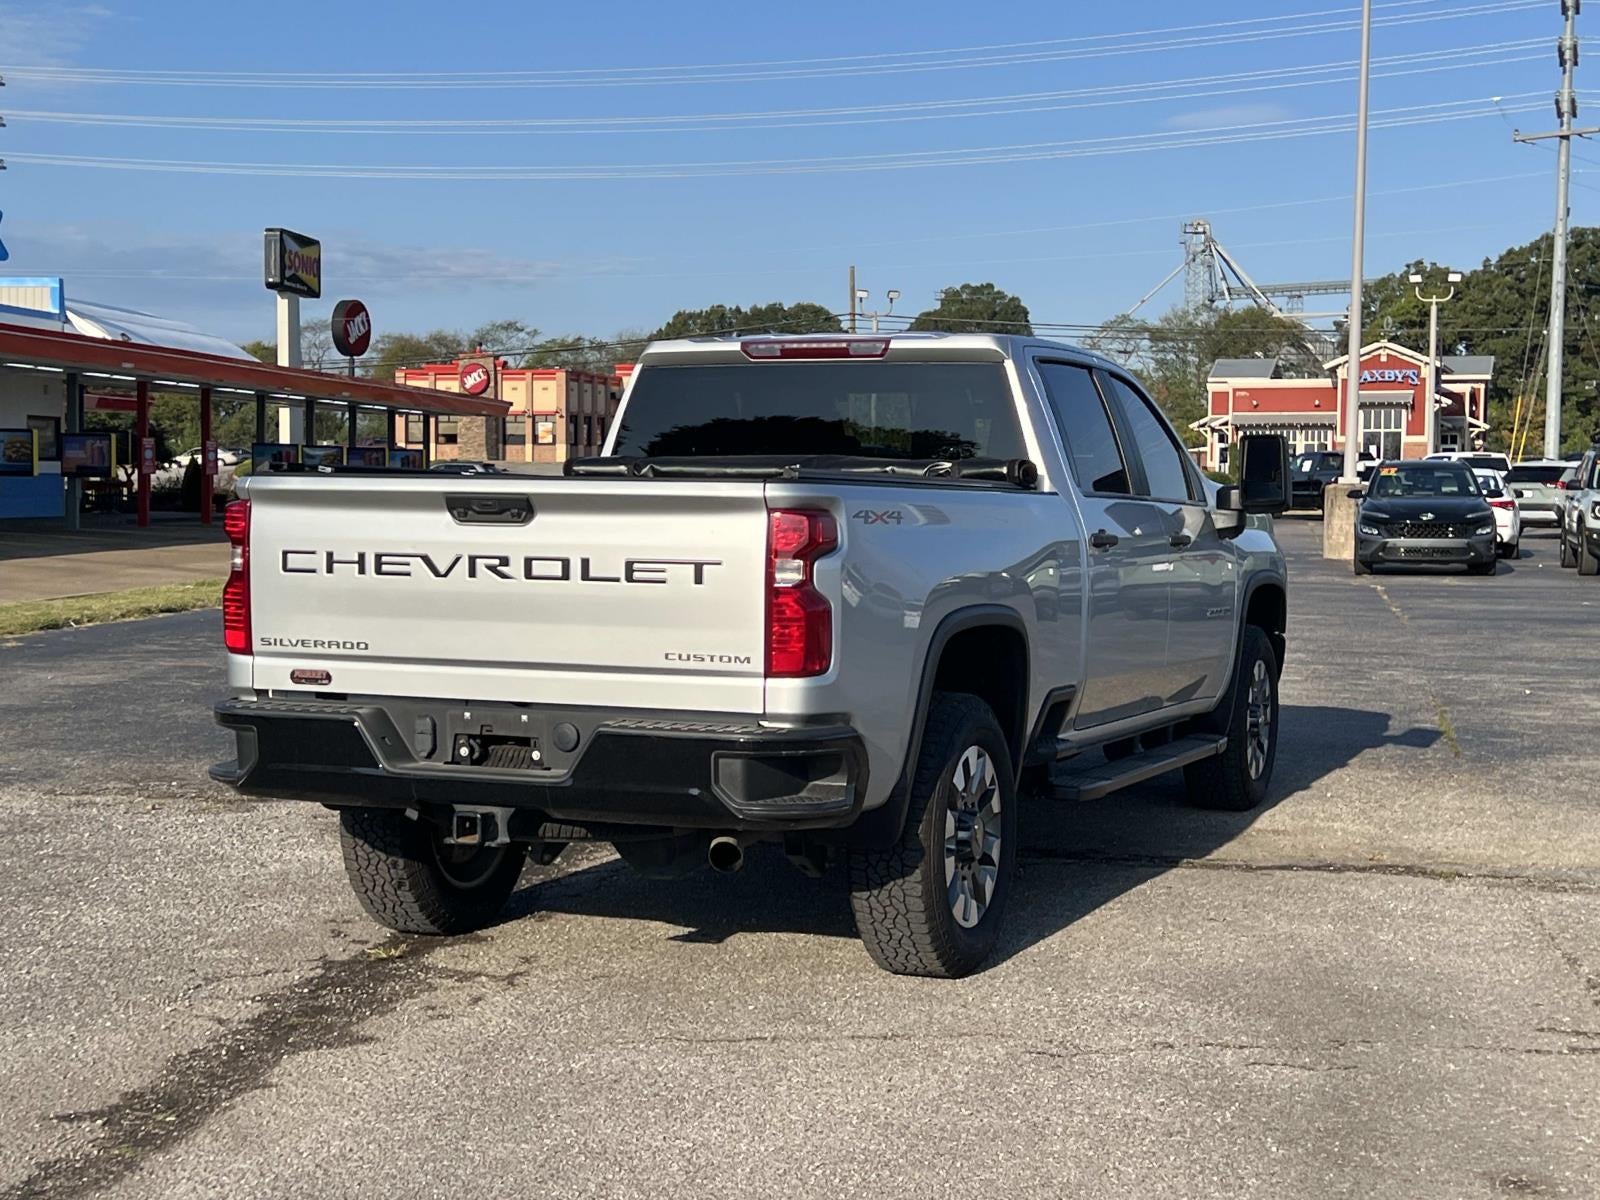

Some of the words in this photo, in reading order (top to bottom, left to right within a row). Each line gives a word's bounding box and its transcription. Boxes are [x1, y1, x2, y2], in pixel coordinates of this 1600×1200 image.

[1360, 369, 1418, 385] AXBY'S
[281, 549, 722, 585] CHEVROLET
[260, 637, 369, 651] SILVERADO
[664, 652, 751, 664] CUSTOM
